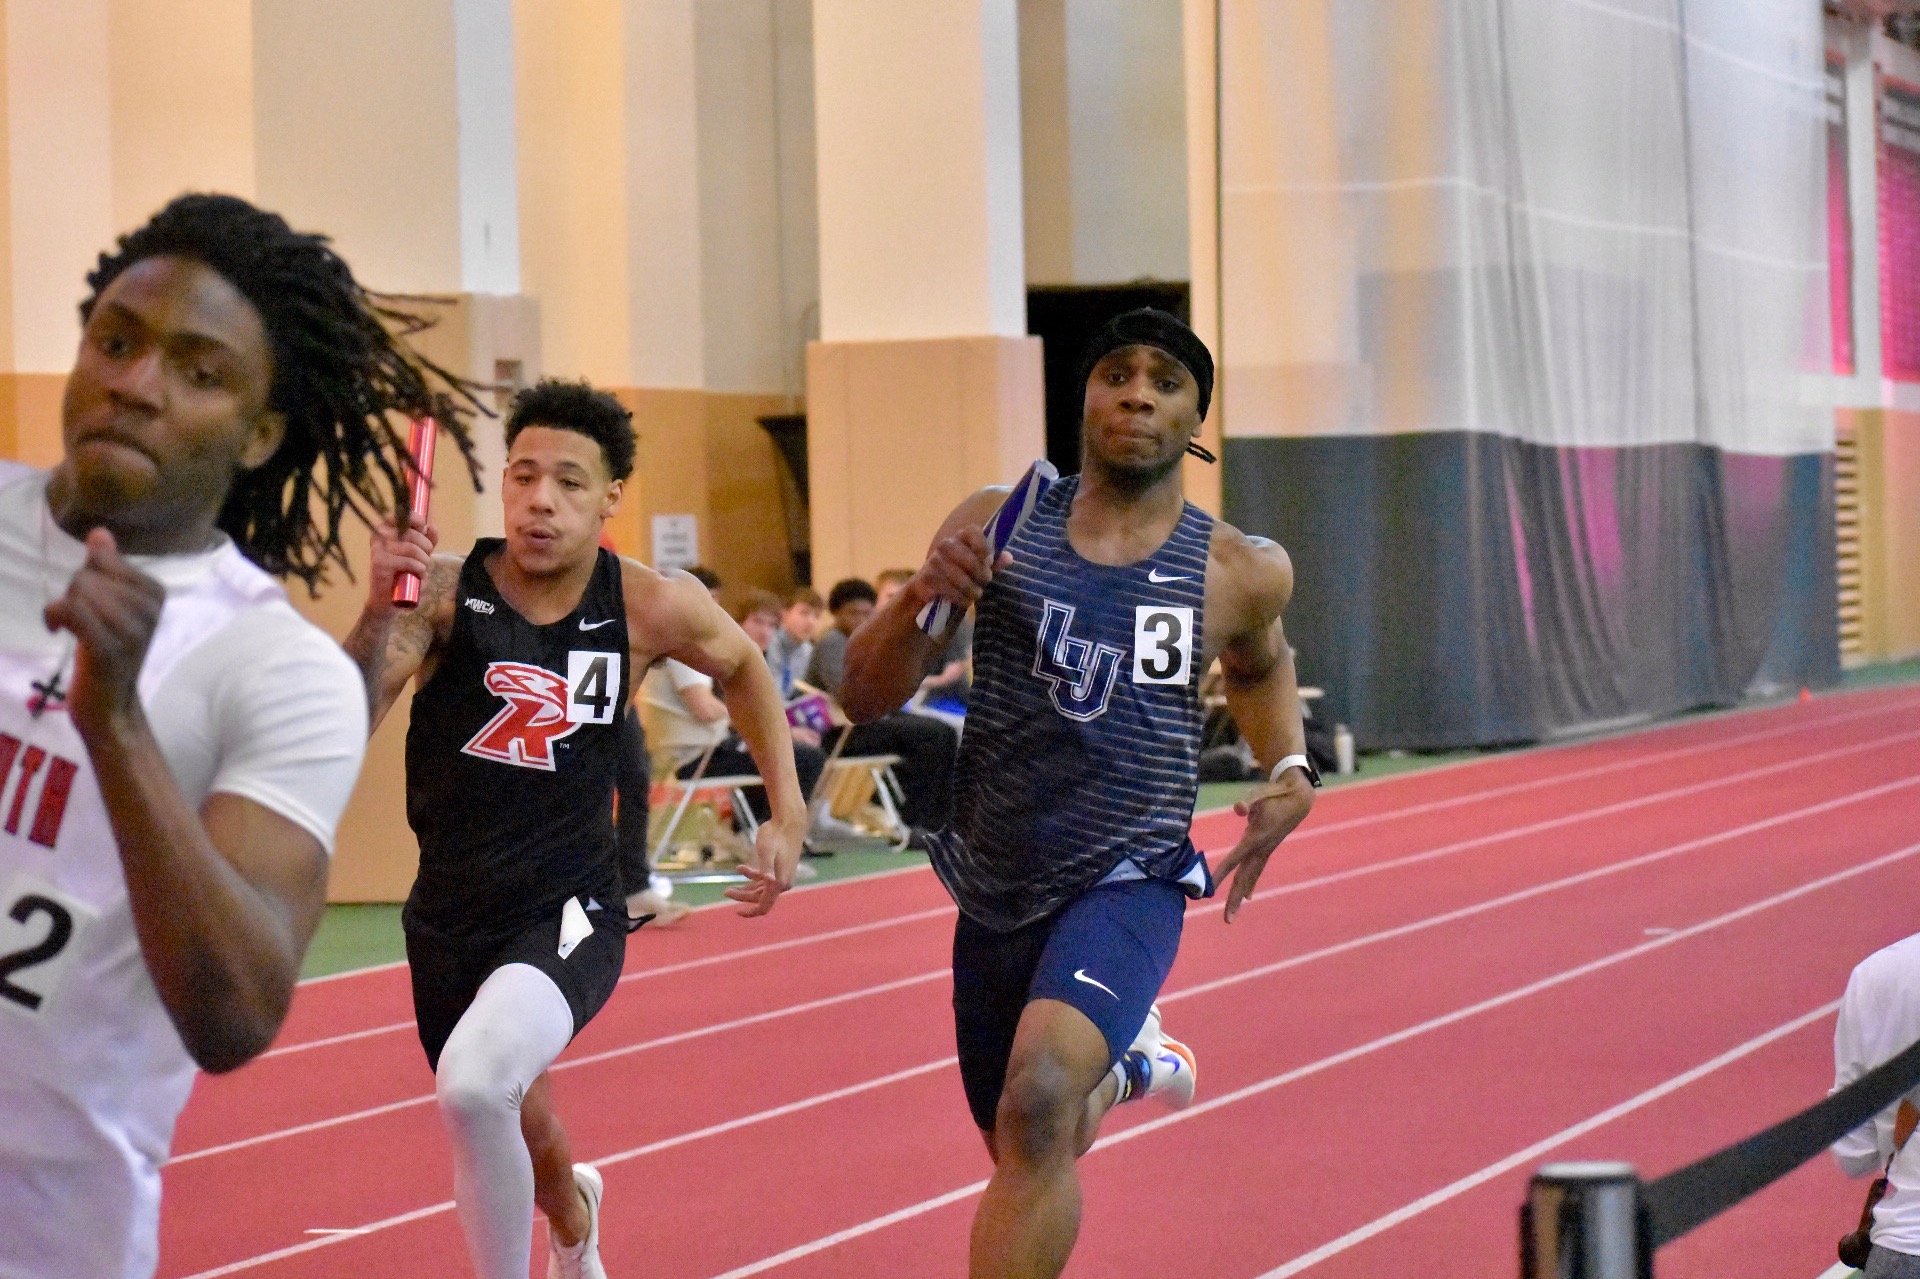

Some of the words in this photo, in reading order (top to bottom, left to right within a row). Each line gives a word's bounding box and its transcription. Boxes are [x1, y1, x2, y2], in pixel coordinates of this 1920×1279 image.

[573, 656, 612, 719] 4
[1031, 598, 1128, 723] LU
[1140, 612, 1183, 680] 3
[0, 893, 73, 1011] 2
